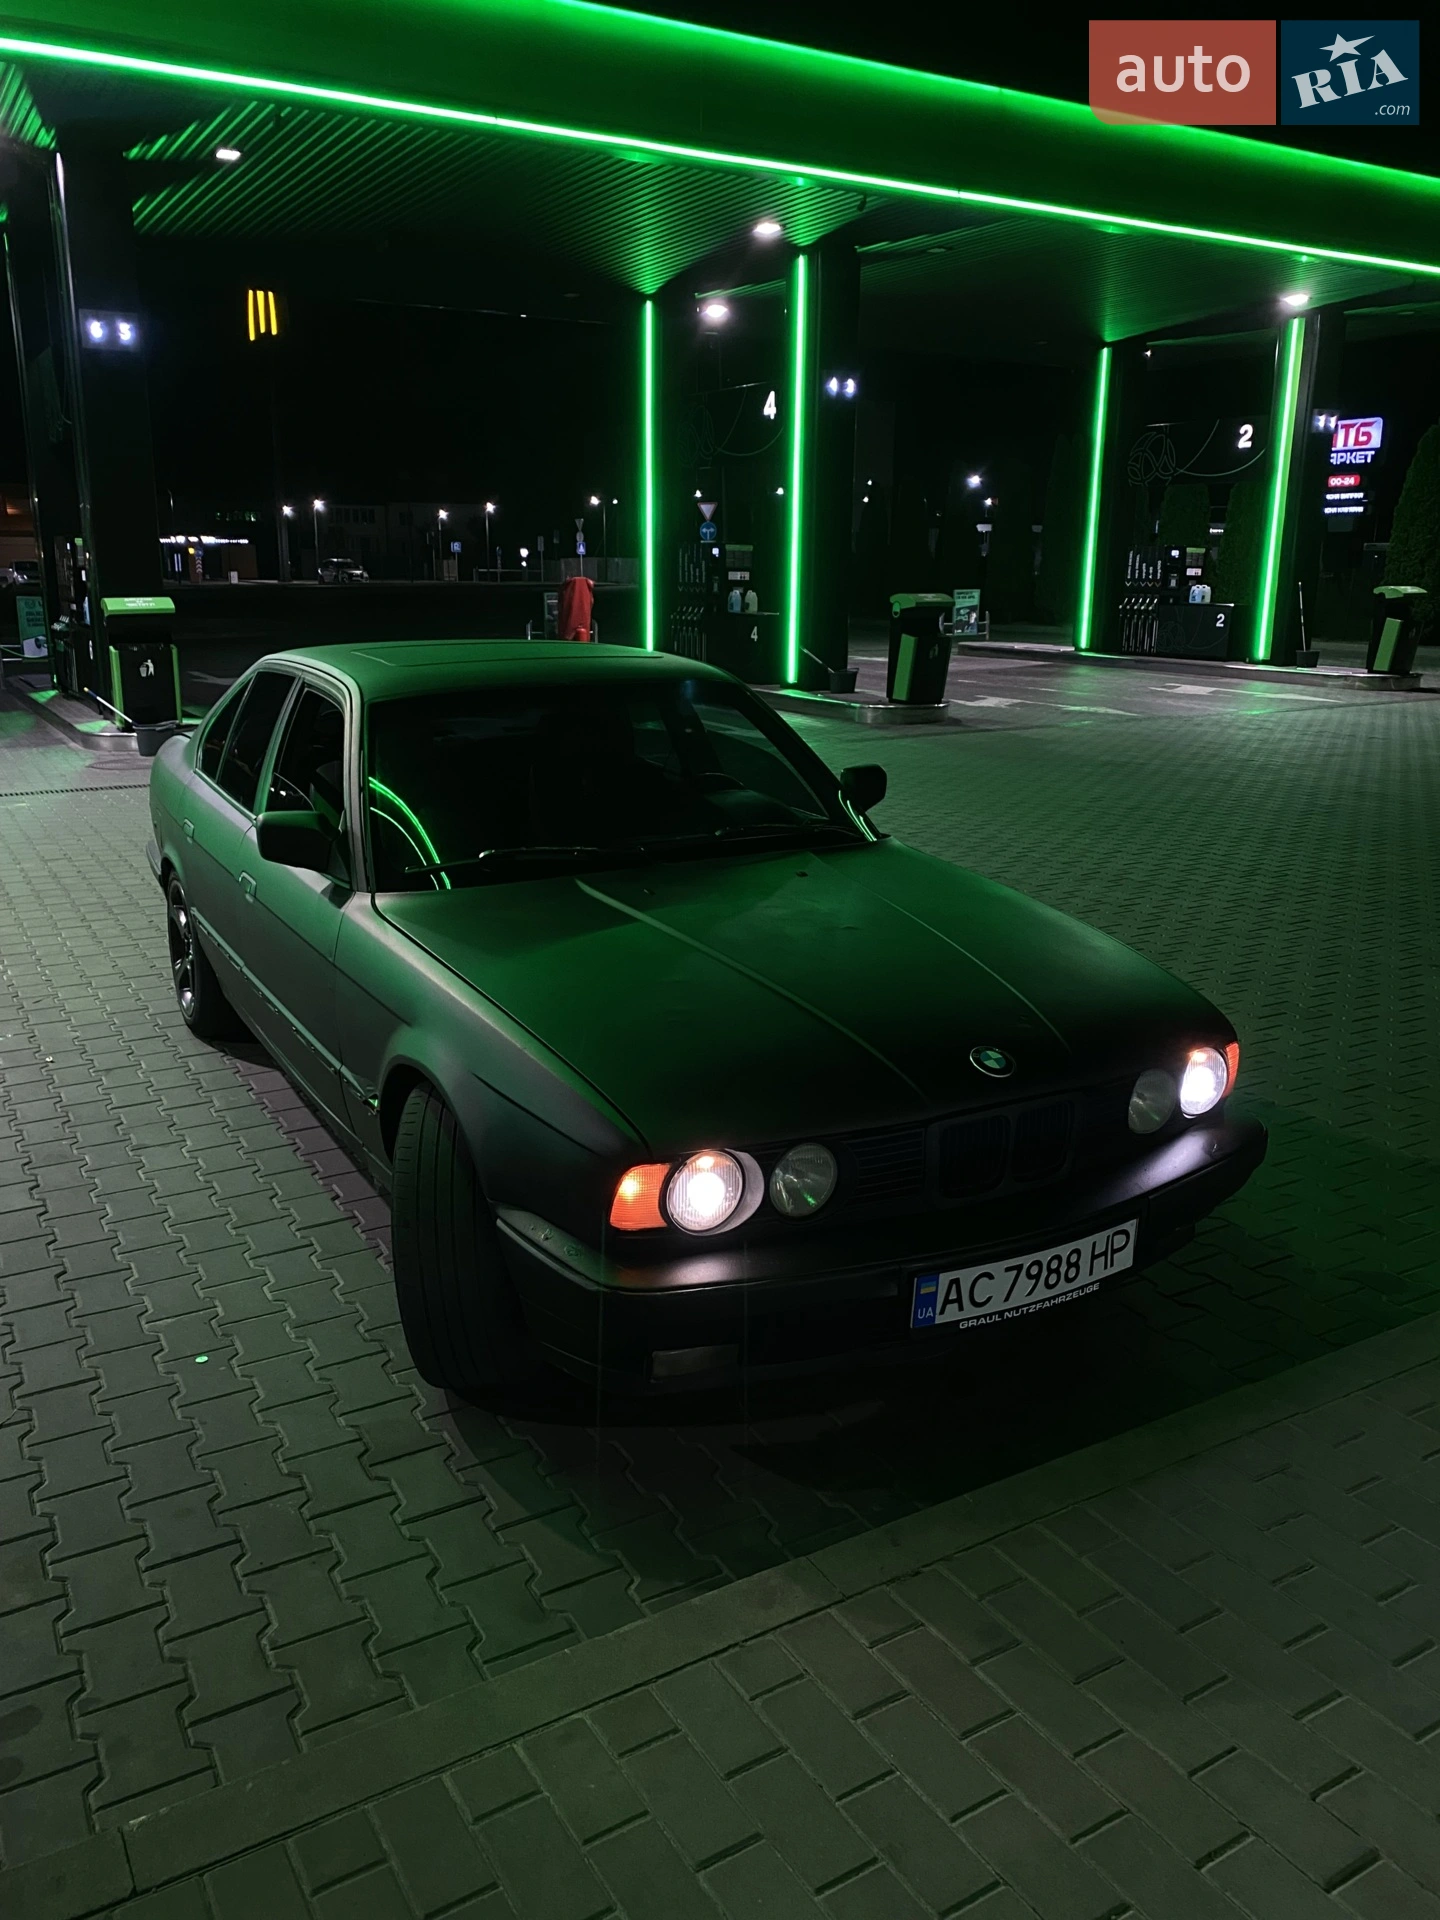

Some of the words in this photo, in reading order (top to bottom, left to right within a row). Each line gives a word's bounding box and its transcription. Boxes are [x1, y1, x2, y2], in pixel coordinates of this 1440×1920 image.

[763, 390, 777, 420] 4
[1237, 423, 1254, 449] 2
[1332, 421, 1377, 448] ТБ
[1216, 613, 1225, 628] 2
[750, 626, 758, 642] 4
[938, 1271, 996, 1316] AC
[1003, 1247, 1082, 1303] 7988
[1088, 1228, 1131, 1277] HP
[917, 1306, 934, 1319] UA
[959, 1311, 1002, 1329] GRAUL
[1003, 1282, 1101, 1320] NUTZFAHRZEUGE
